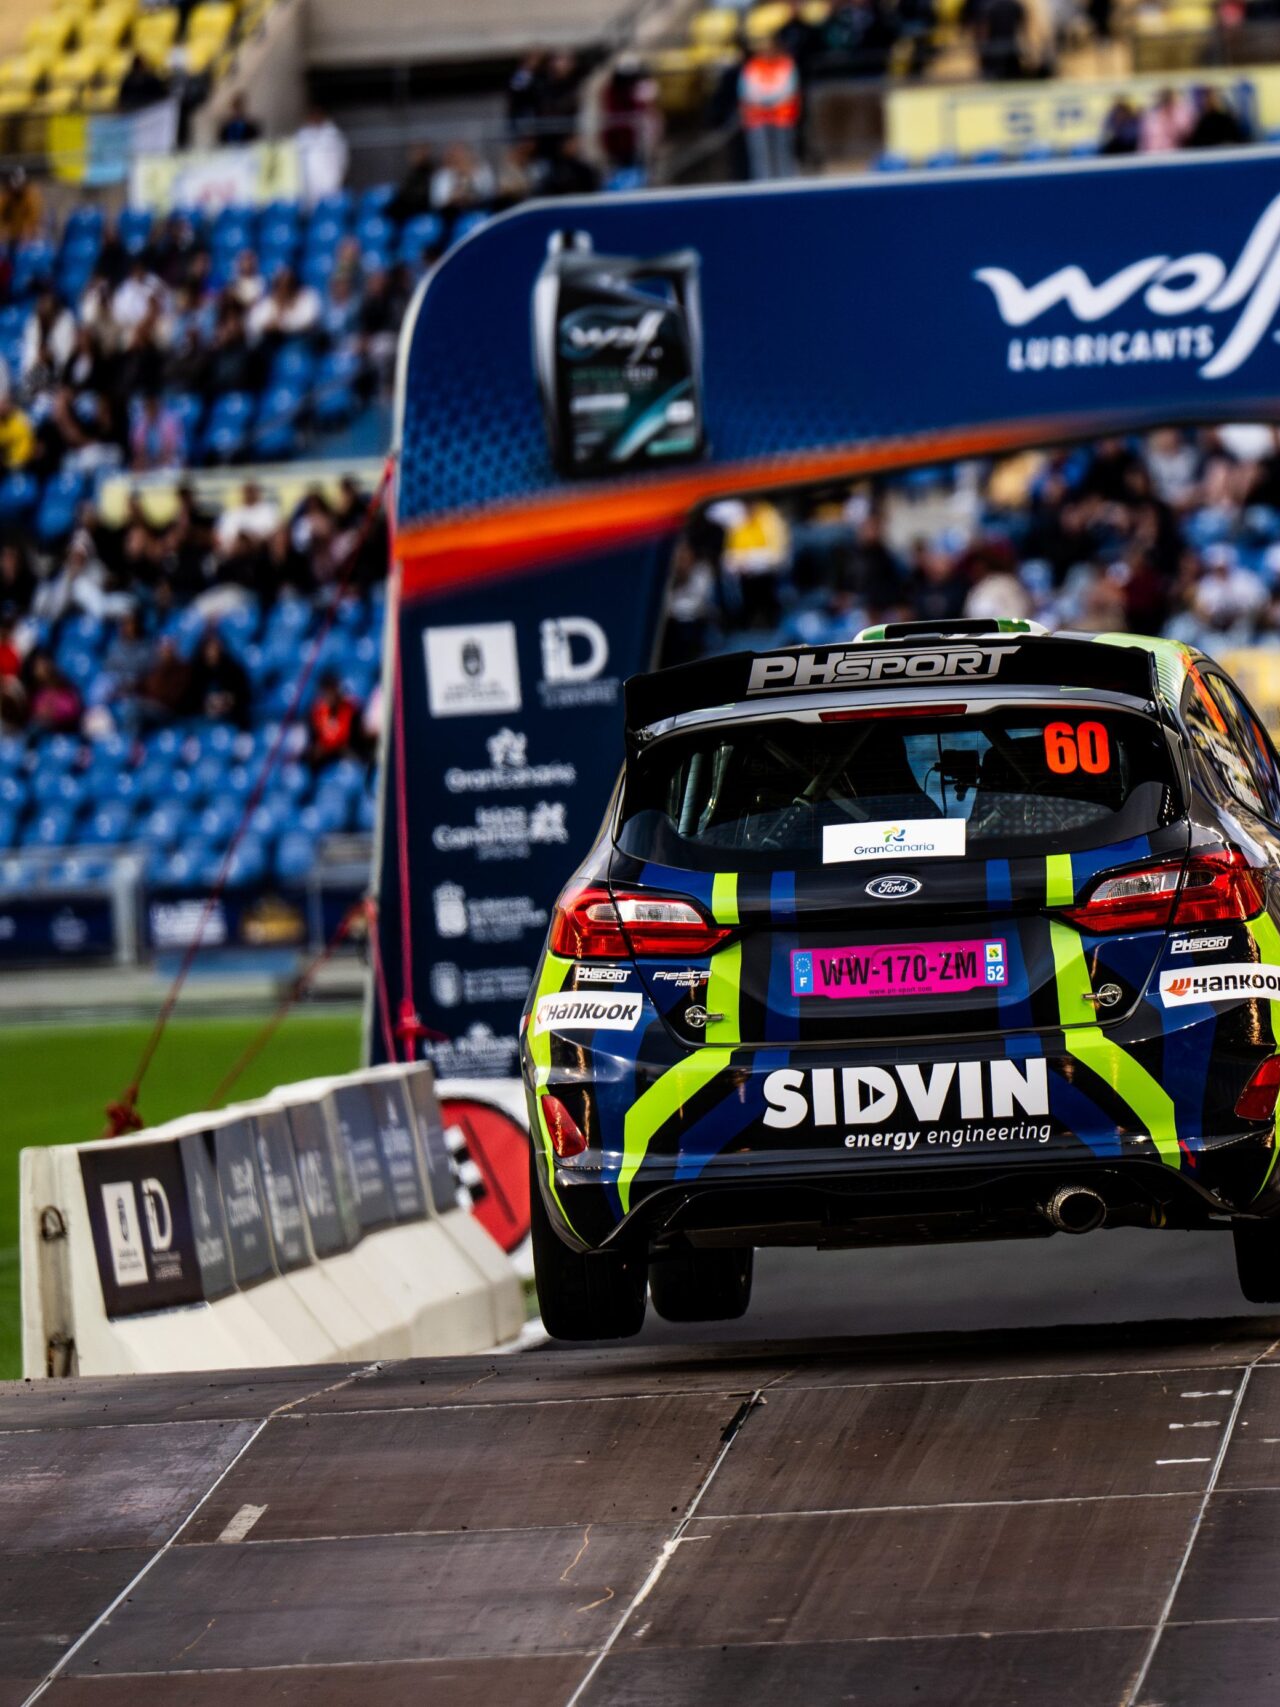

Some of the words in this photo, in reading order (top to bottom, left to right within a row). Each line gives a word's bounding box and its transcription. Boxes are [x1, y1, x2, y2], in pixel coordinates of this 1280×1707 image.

[1007, 324, 1214, 372] LUBRICANTS
[746, 645, 1022, 692] PHSPORT
[1044, 721, 1110, 774] 60
[854, 841, 935, 855] GranCanaria
[877, 878, 908, 895] Ford
[800, 977, 808, 988] F
[820, 951, 977, 986] WW-170-ZM
[987, 965, 1005, 982] 52
[762, 1057, 1050, 1129] SIDVIN
[844, 1130, 921, 1150] energy
[926, 1122, 1051, 1148] engineering
